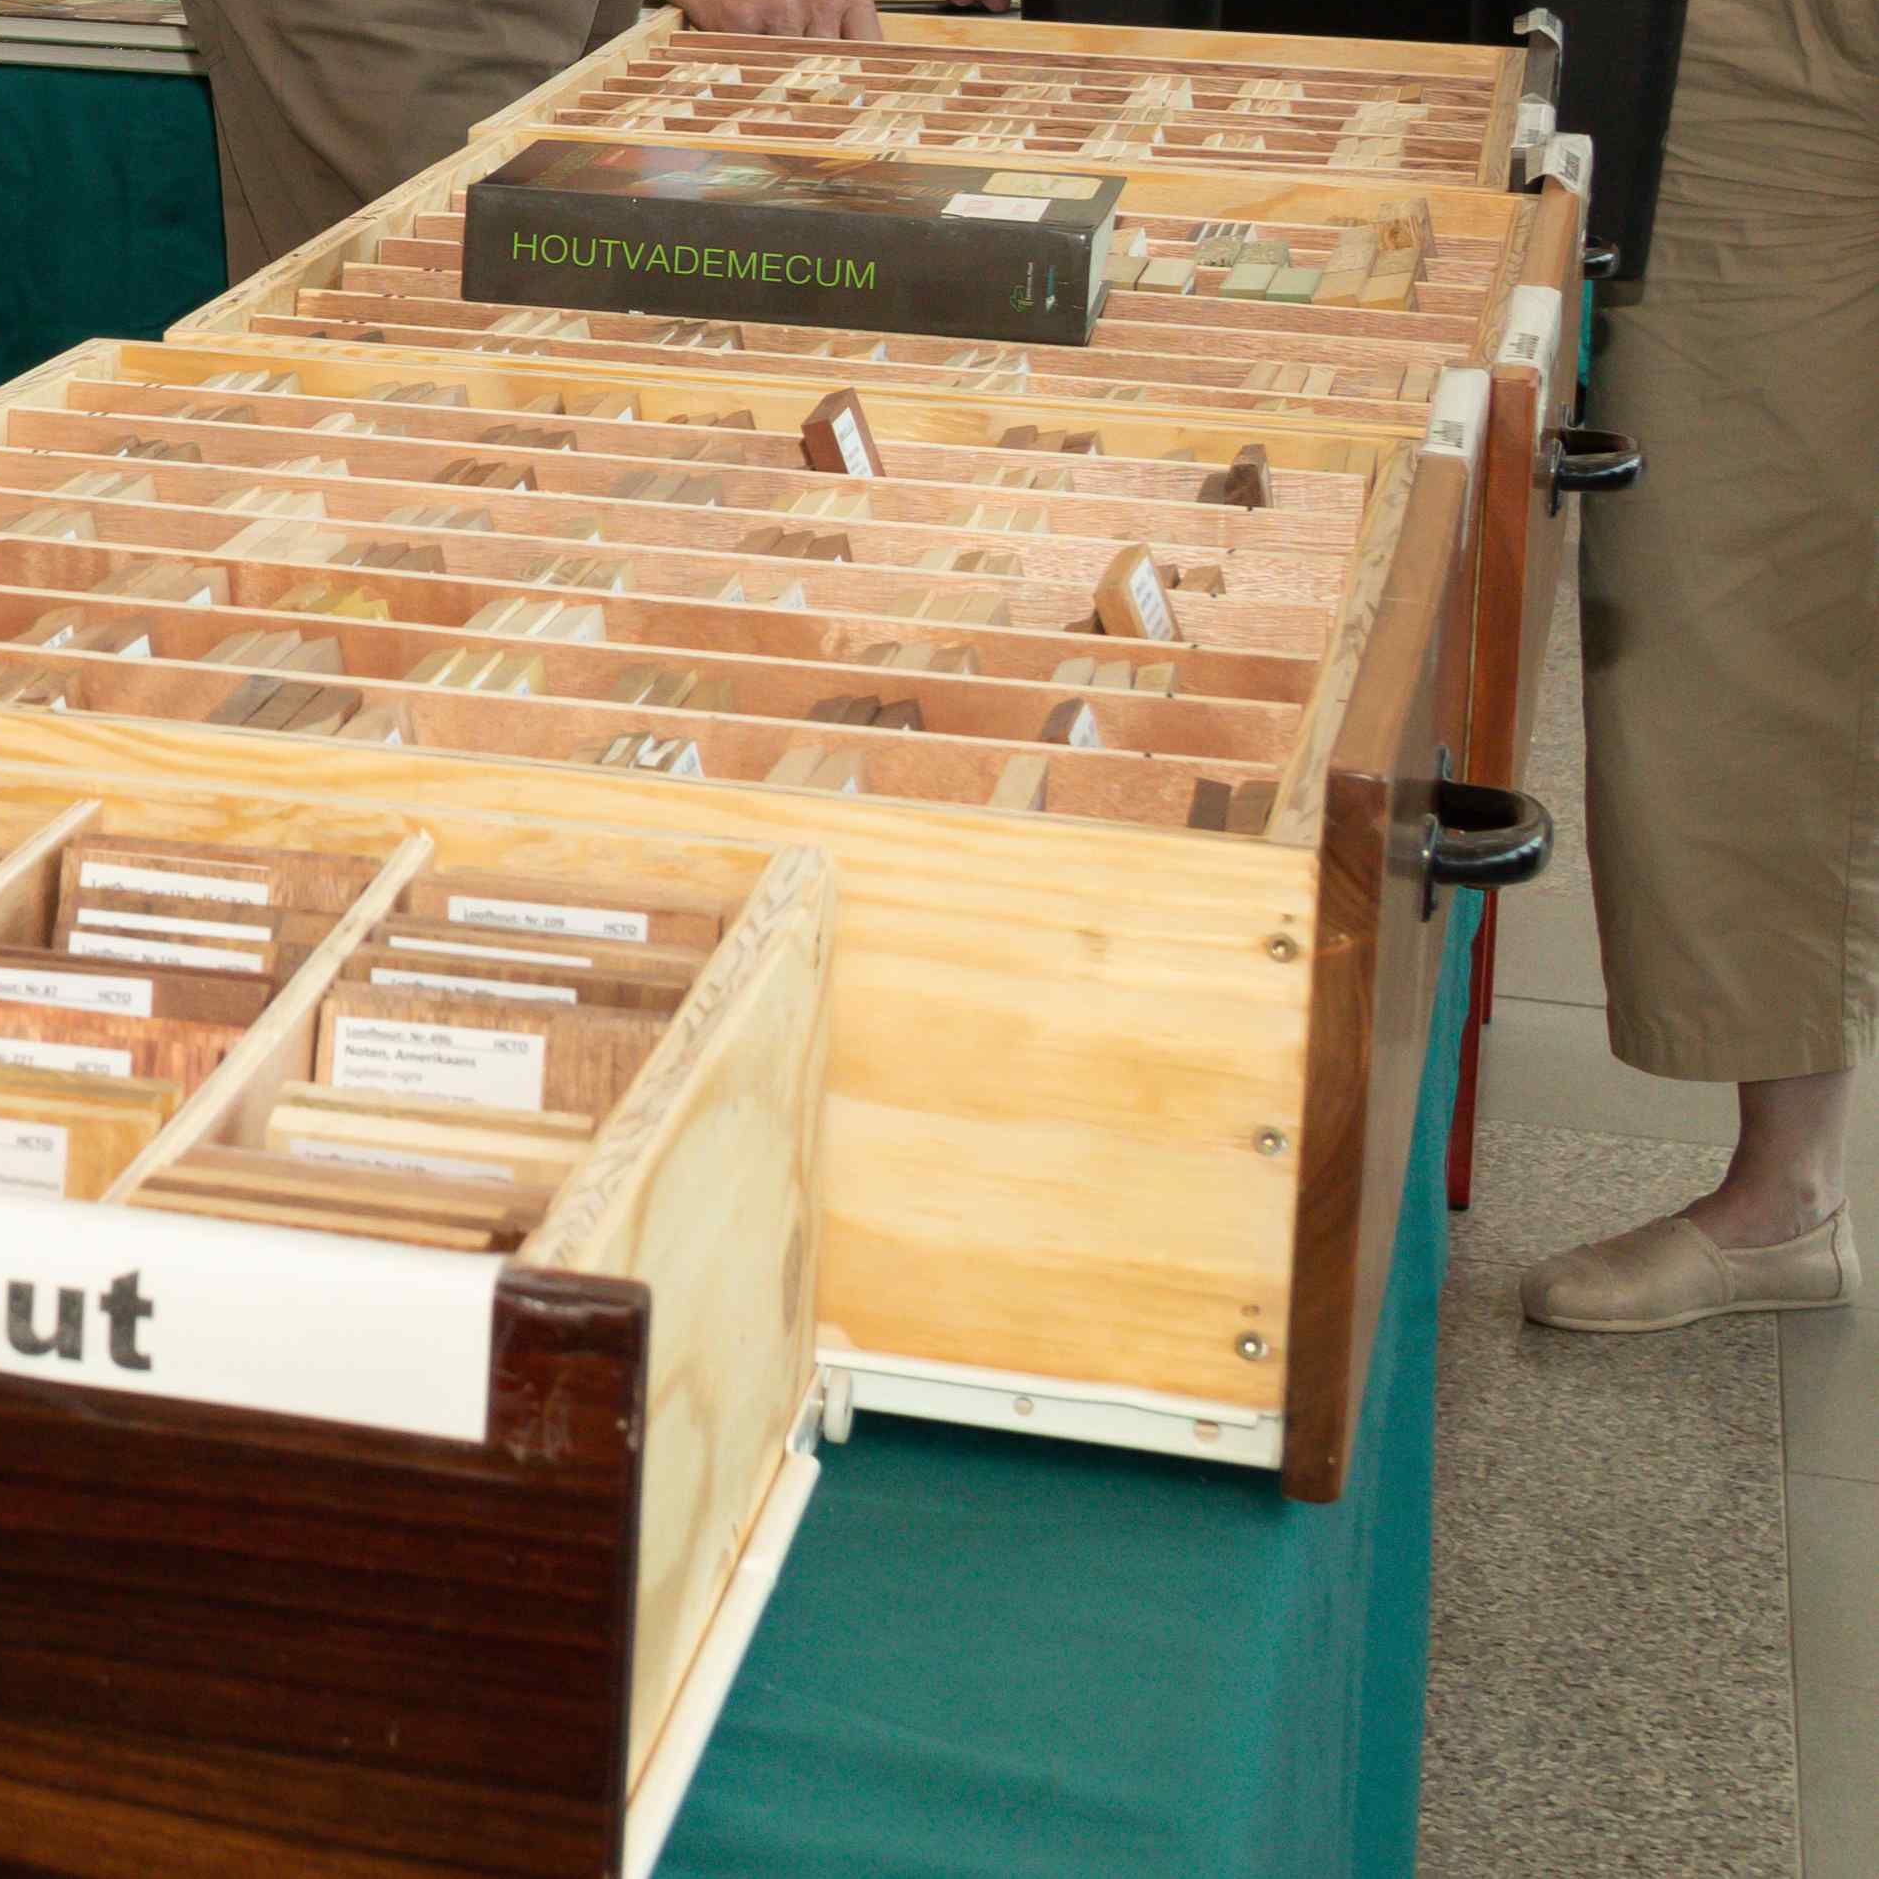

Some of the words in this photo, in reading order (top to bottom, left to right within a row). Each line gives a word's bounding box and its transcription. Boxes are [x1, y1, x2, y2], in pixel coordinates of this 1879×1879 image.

[511, 231, 877, 290] HOUTVADEMECUM
[462, 908, 519, 925] Loofhout:
[602, 921, 638, 937] HCTO
[97, 990, 132, 1005] HCTO
[345, 1025, 407, 1043] Loofhout:
[492, 1039, 530, 1054] HCTO
[344, 1044, 391, 1062] Noten,
[394, 1049, 477, 1070] Amerikaans
[16, 1136, 54, 1152] HCTO
